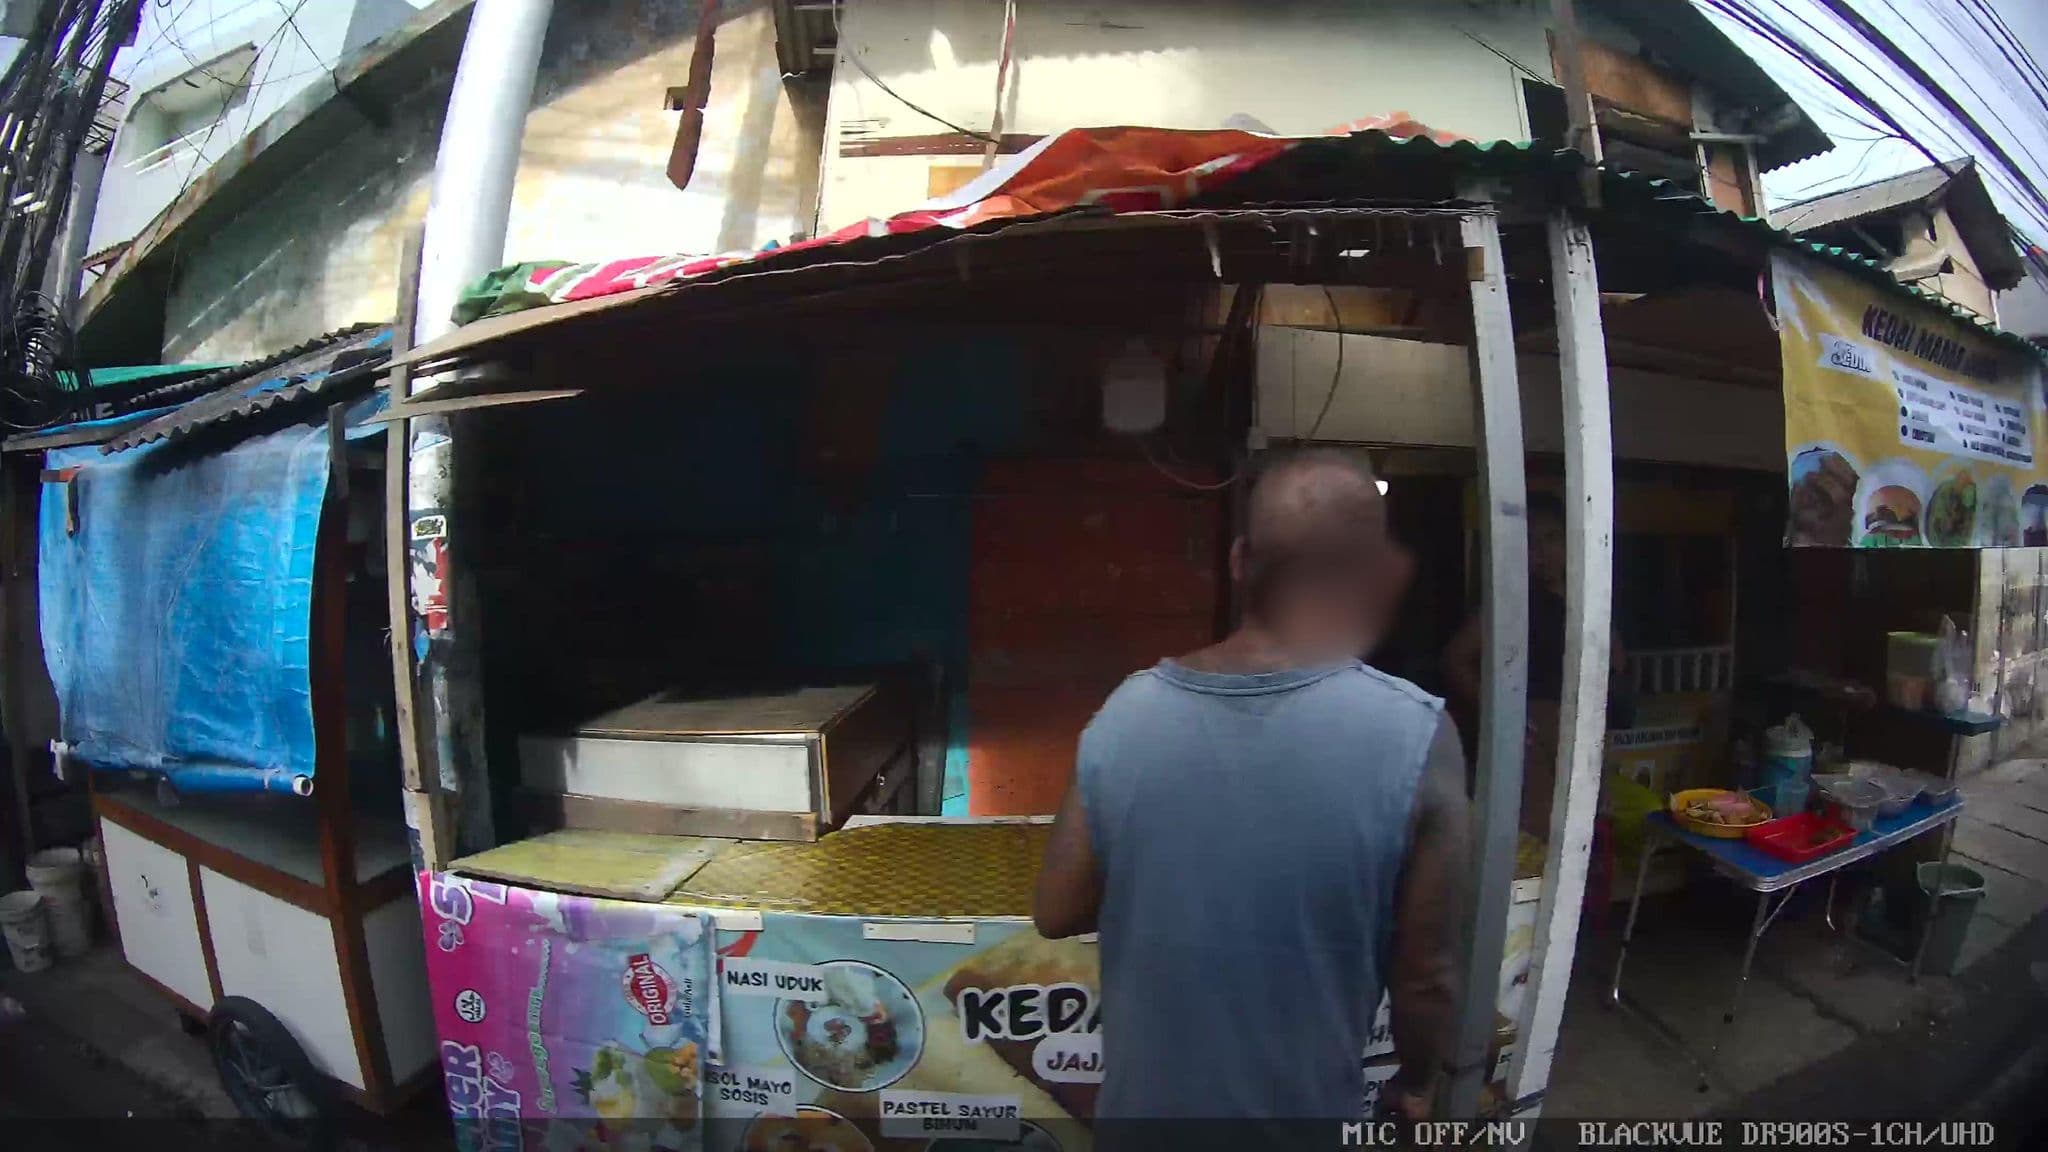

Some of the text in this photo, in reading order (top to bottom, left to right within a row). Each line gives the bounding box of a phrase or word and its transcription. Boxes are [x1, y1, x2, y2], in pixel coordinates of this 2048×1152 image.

[631, 956, 667, 1024] ORIGINAL
[727, 971, 824, 992] NASI UDUK
[1047, 1052, 1102, 1071] JAJ
[747, 1076, 792, 1094] MAYO
[720, 1088, 769, 1105] SOSIS
[883, 1101, 1017, 1119] PASTEL SAYUR
[923, 1117, 978, 1131] BIHUN
